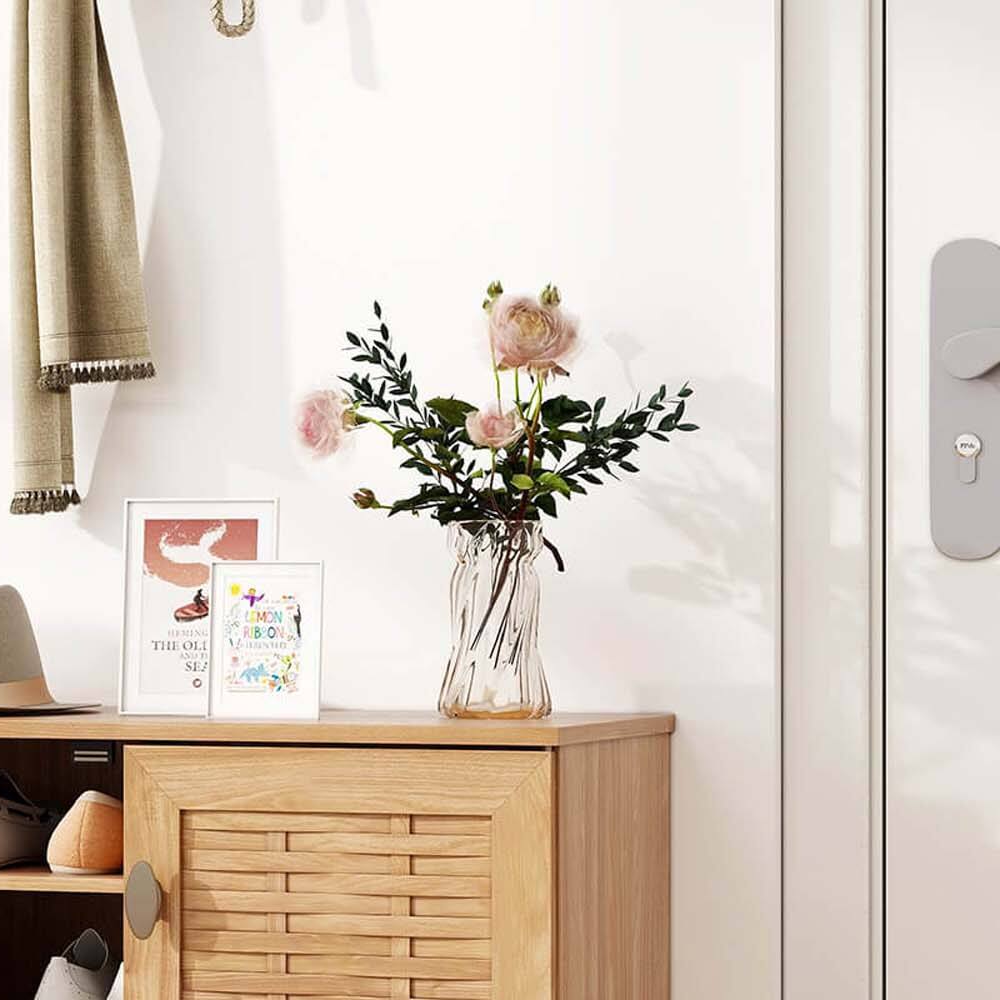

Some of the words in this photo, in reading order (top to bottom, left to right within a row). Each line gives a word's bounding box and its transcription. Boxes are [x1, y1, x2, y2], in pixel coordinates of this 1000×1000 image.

[245, 610, 283, 624] LEMON
[243, 625, 285, 640] RIBBON
[151, 640, 180, 651] THE
